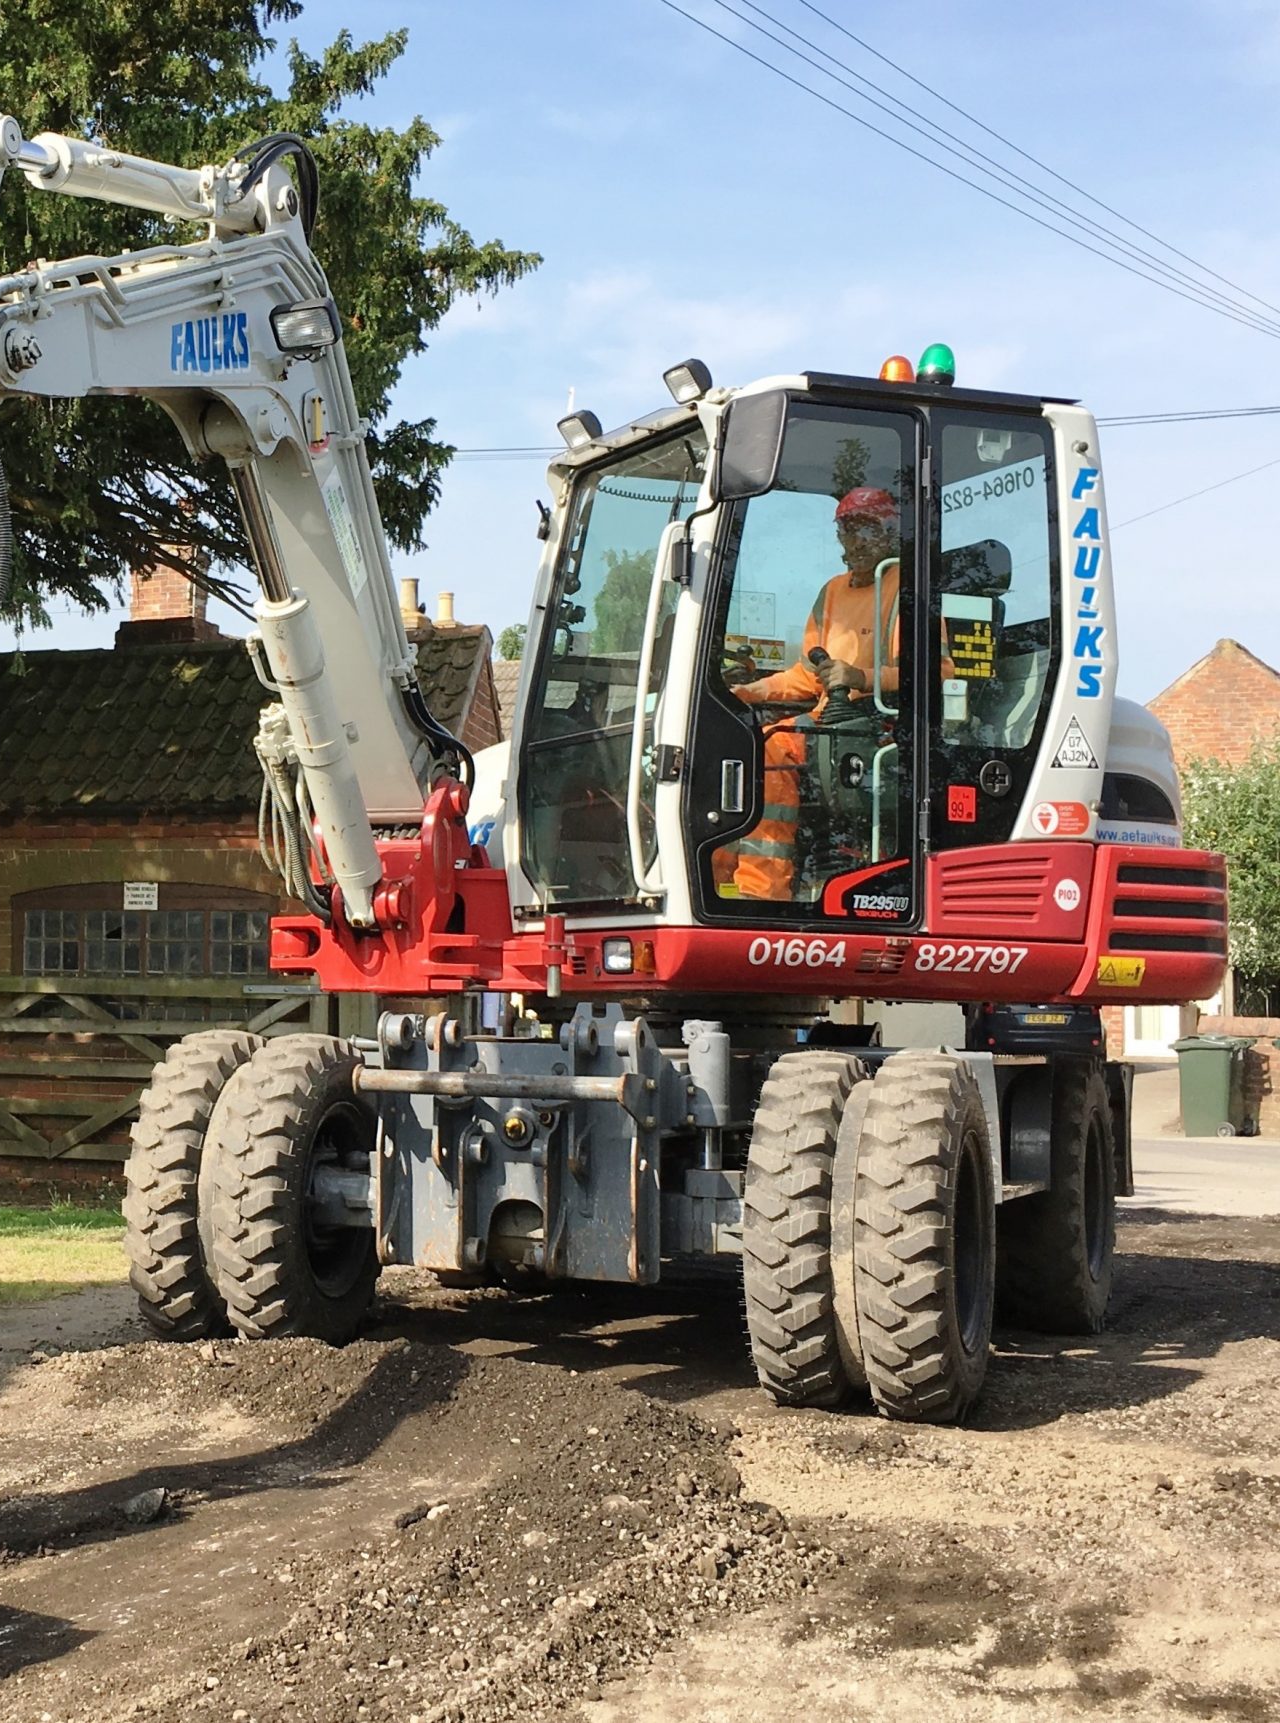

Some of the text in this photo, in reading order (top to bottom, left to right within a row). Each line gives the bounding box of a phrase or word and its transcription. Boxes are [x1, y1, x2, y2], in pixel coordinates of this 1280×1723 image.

[172, 313, 250, 375] FAULKS
[1071, 467, 1105, 698] FAULKS
[853, 895, 909, 911] TB295W
[748, 937, 1028, 974] 01664 822797
